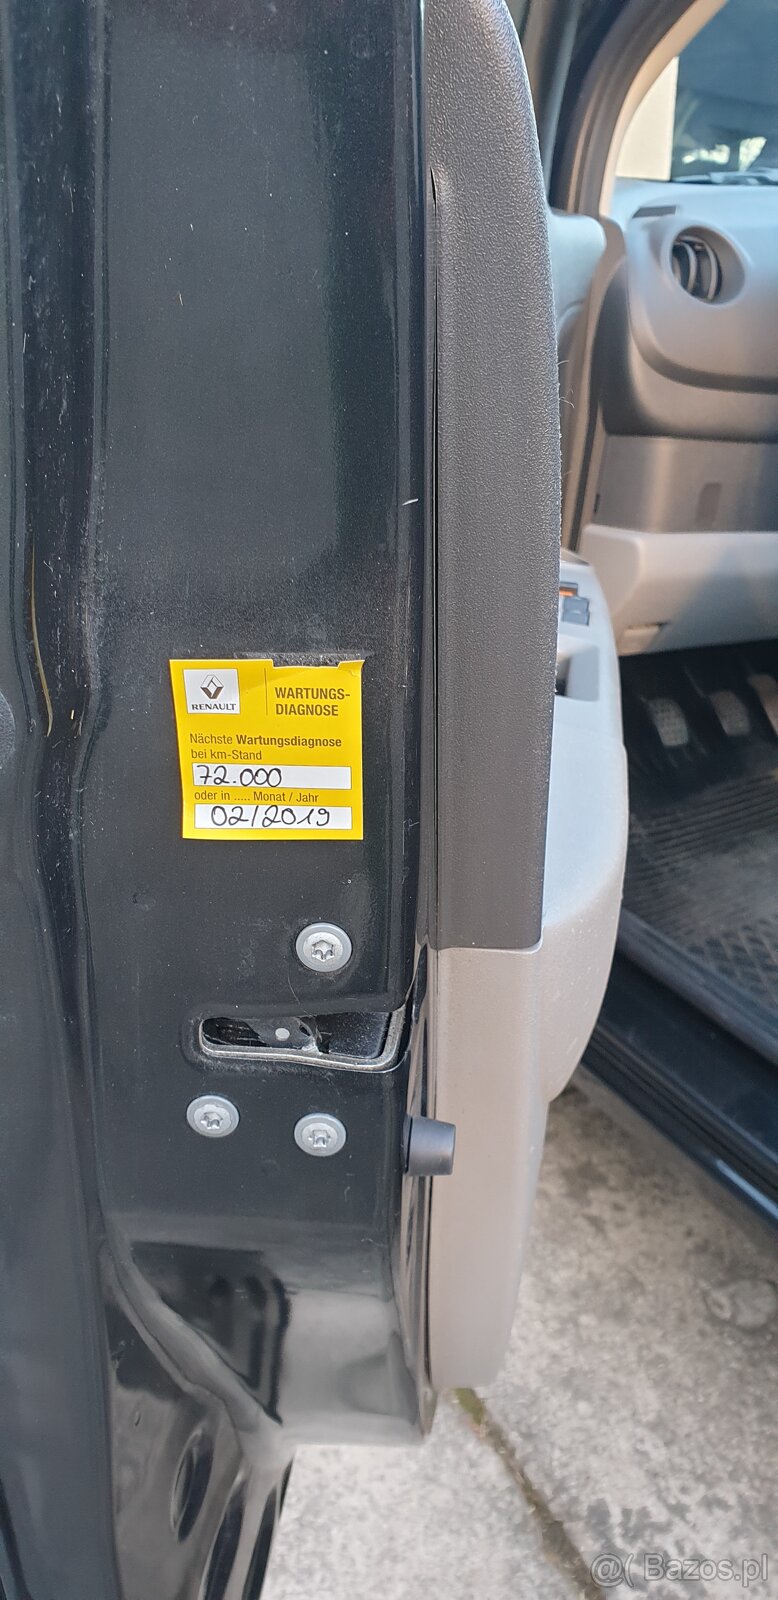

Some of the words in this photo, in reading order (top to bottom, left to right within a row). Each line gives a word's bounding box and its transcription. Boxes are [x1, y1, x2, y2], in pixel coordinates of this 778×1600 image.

[275, 687, 350, 700] WARTUNGS-
[276, 704, 338, 716] DIAGNOSE
[190, 734, 233, 744] Nächste
[236, 735, 342, 748] Wartungsdiagnose
[191, 749, 208, 759] bei
[211, 749, 262, 760] km-Stand
[196, 765, 282, 787] 72.000
[194, 791, 217, 801] oder
[221, 791, 230, 800] in
[253, 791, 286, 802] Monat
[289, 792, 293, 802] /
[296, 792, 319, 803] Jahr
[211, 805, 330, 827] 02/2019
